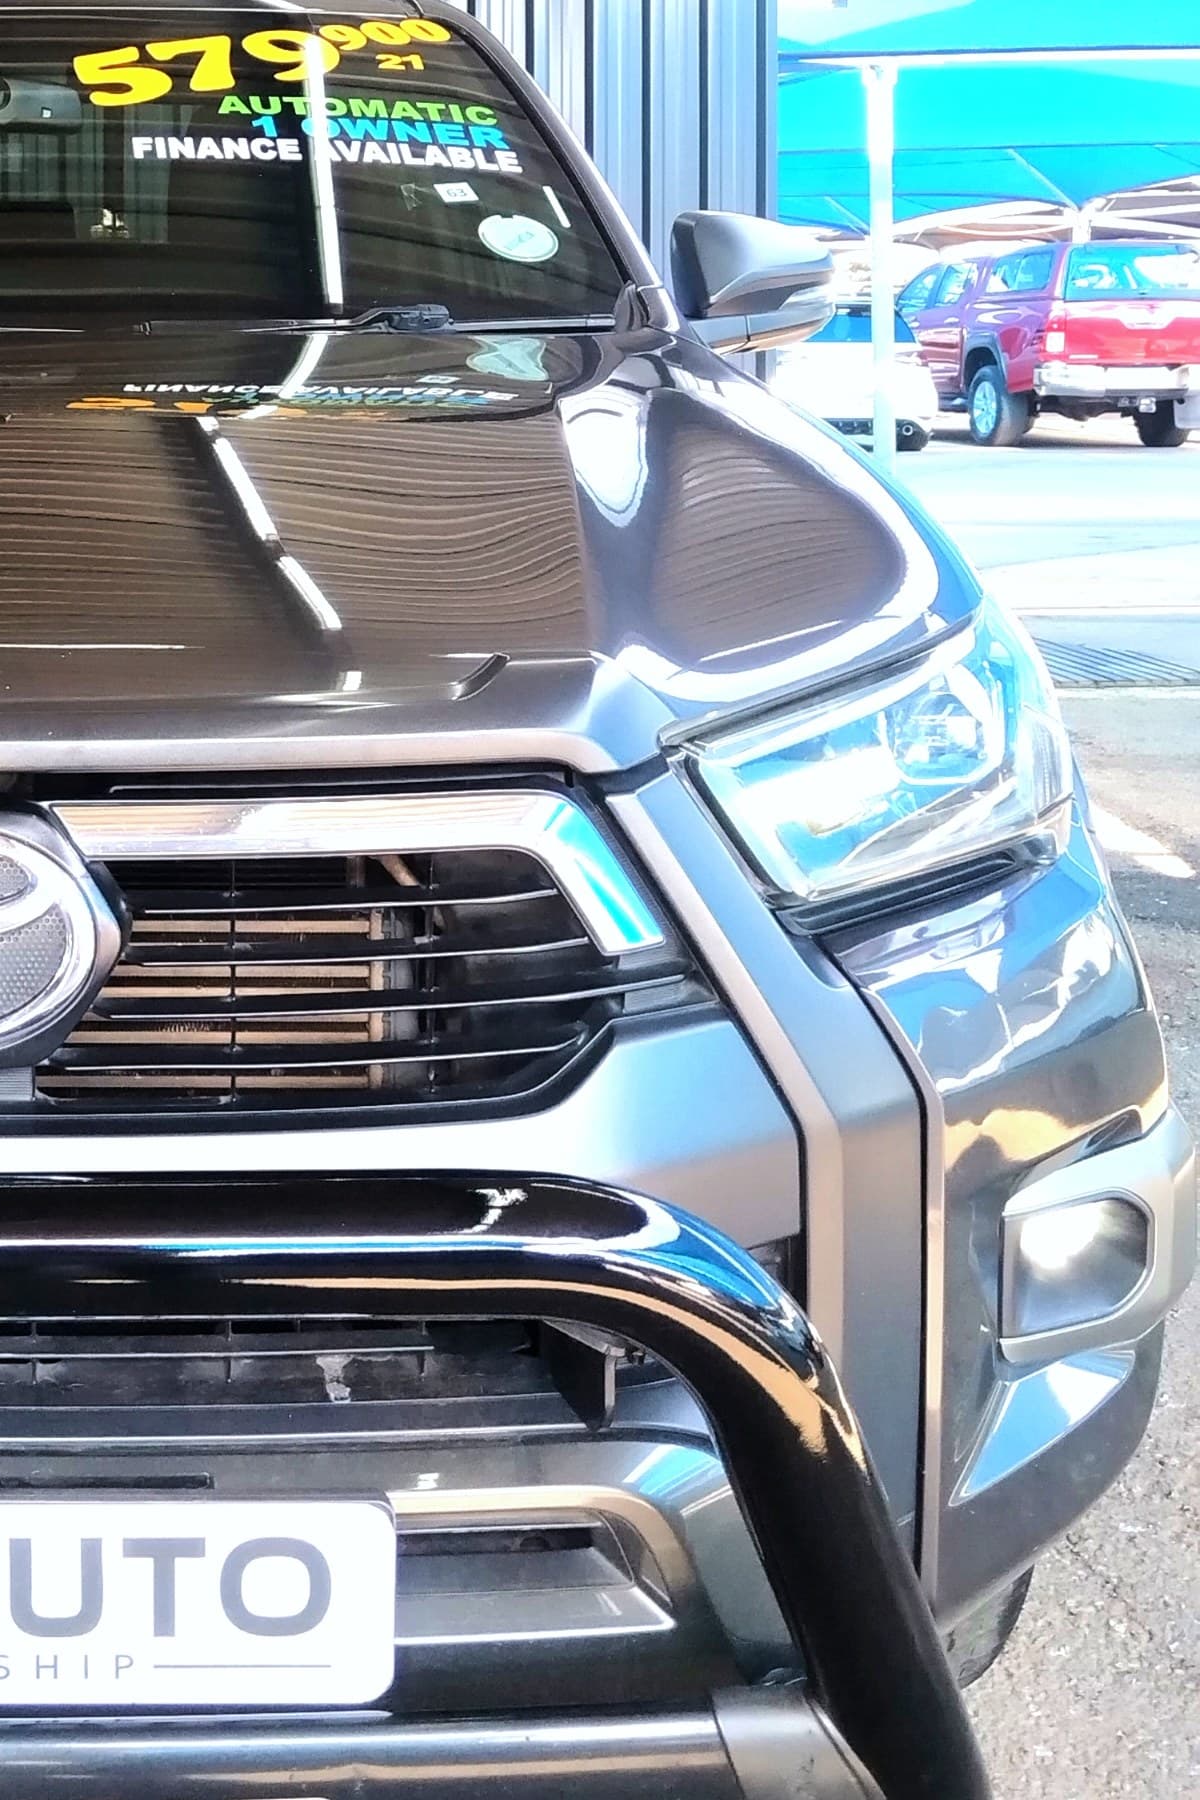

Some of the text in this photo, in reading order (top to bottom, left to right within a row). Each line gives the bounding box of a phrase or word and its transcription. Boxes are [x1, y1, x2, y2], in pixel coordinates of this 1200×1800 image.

[73, 18, 452, 107] 579 900
[375, 53, 425, 71] 21
[217, 96, 498, 125] AUTOMATIC
[251, 115, 510, 149] 1 OWNER
[131, 136, 523, 174] FINANCE AVAILABLE
